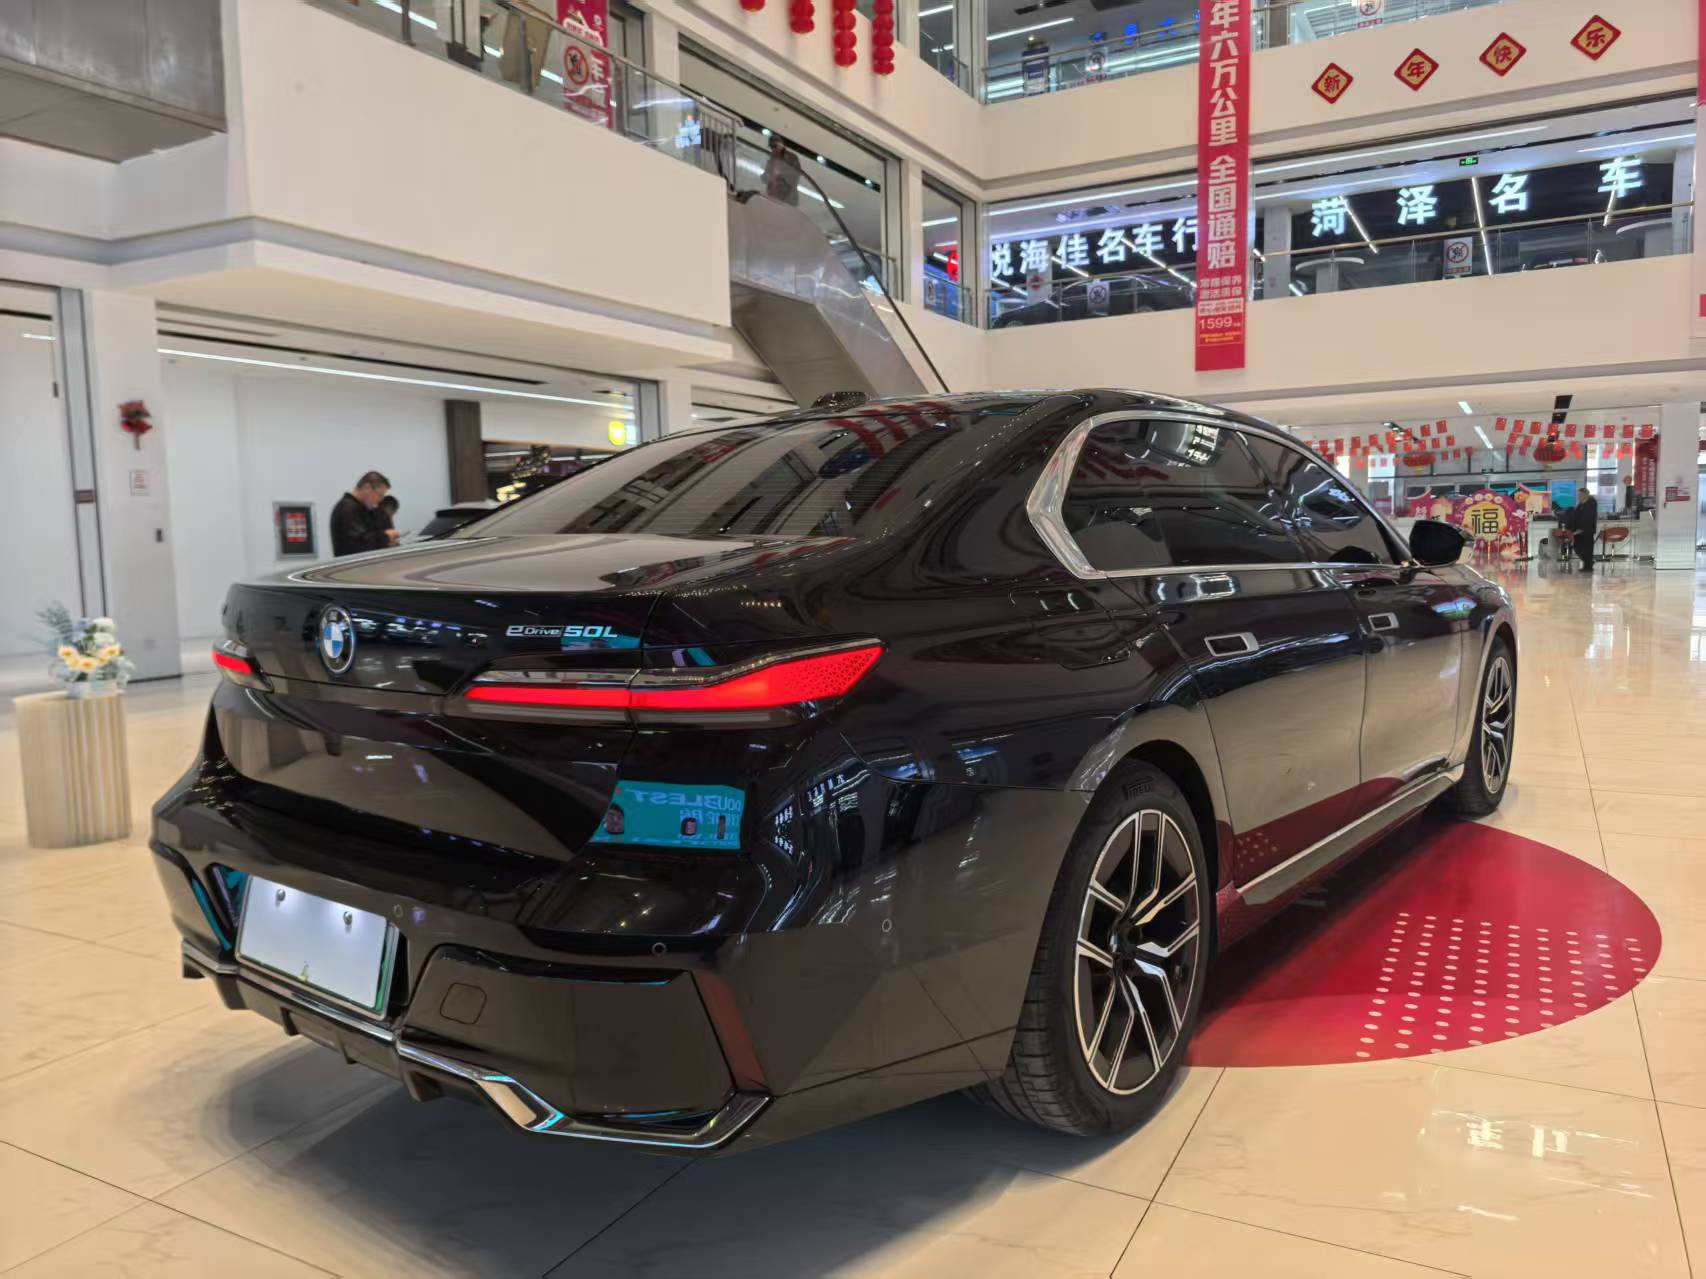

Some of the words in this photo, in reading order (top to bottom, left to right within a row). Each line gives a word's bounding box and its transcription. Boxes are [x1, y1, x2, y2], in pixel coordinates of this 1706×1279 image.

[1323, 27, 1606, 93] 新年快乐
[1207, 154, 1237, 269] 全国通赔
[1311, 156, 1644, 238] 菏泽名车
[1200, 316, 1232, 330] 1599
[1471, 508, 1499, 534] 福
[505, 625, 561, 637] eDrive
[563, 625, 618, 637] 50L
